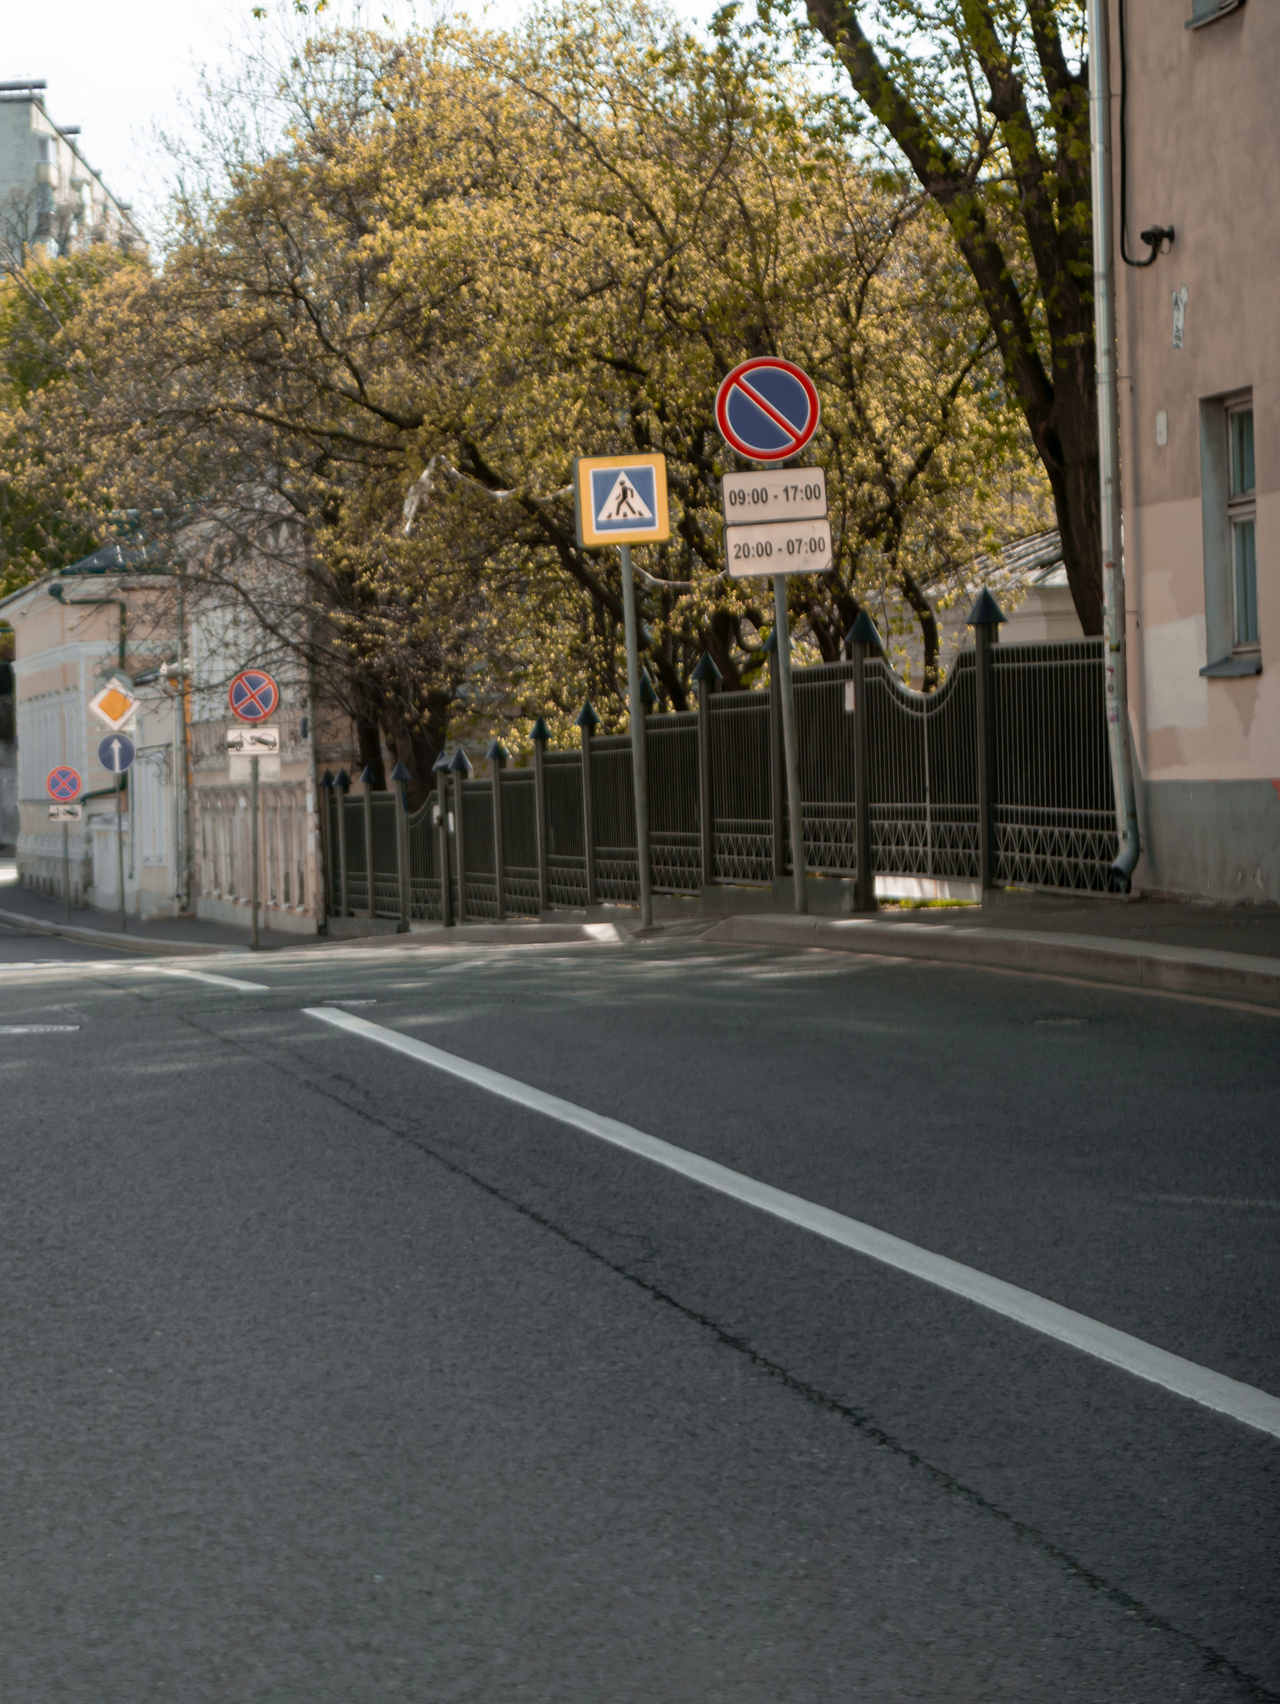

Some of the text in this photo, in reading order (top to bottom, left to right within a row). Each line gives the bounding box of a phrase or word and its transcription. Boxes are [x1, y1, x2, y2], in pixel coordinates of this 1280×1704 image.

[729, 487, 768, 506] 09:00
[783, 483, 821, 502] 17:00
[733, 541, 773, 559] 20:00
[787, 536, 826, 555] 07:00
